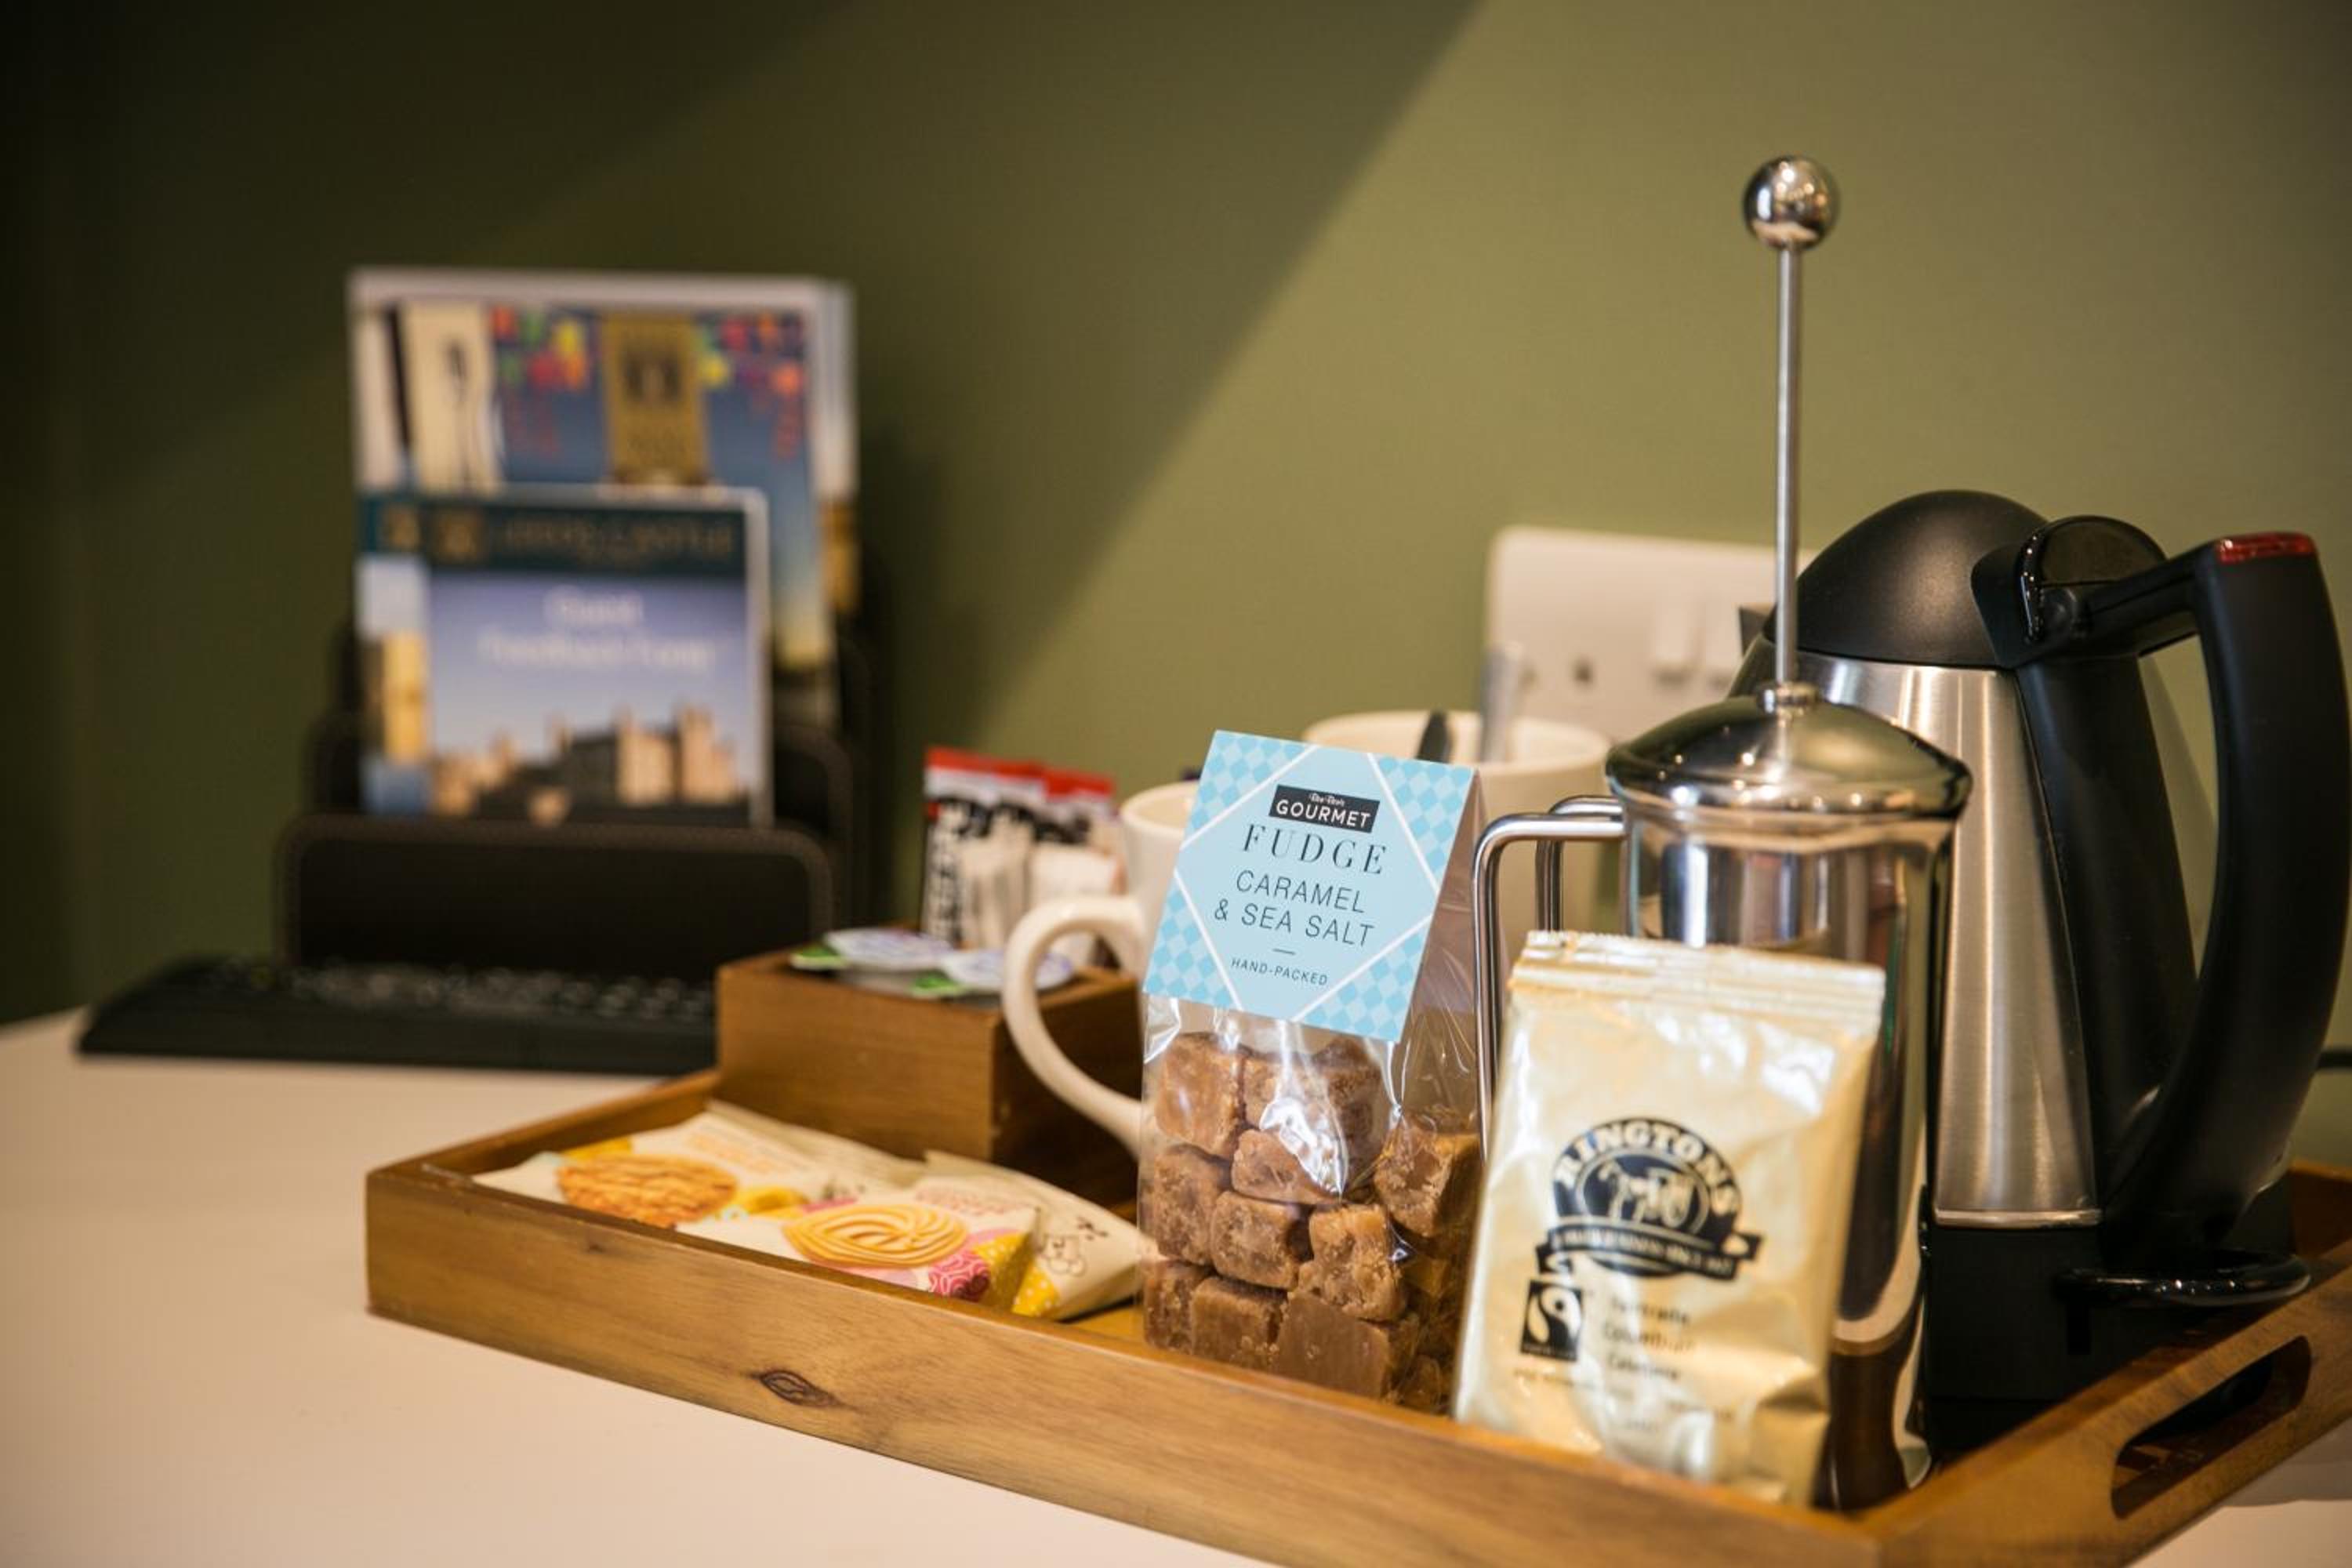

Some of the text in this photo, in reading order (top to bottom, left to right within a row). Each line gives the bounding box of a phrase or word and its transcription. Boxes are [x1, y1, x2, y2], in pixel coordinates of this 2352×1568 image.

[1276, 799, 1370, 828] GOURMET
[1243, 824, 1386, 874] FUDGE
[1236, 869, 1365, 913] CARAMEL
[1214, 898, 1374, 947] & SEA SALT
[1231, 958, 1328, 985] HAND-PACKED
[1555, 1121, 1738, 1214] RINGTONS
